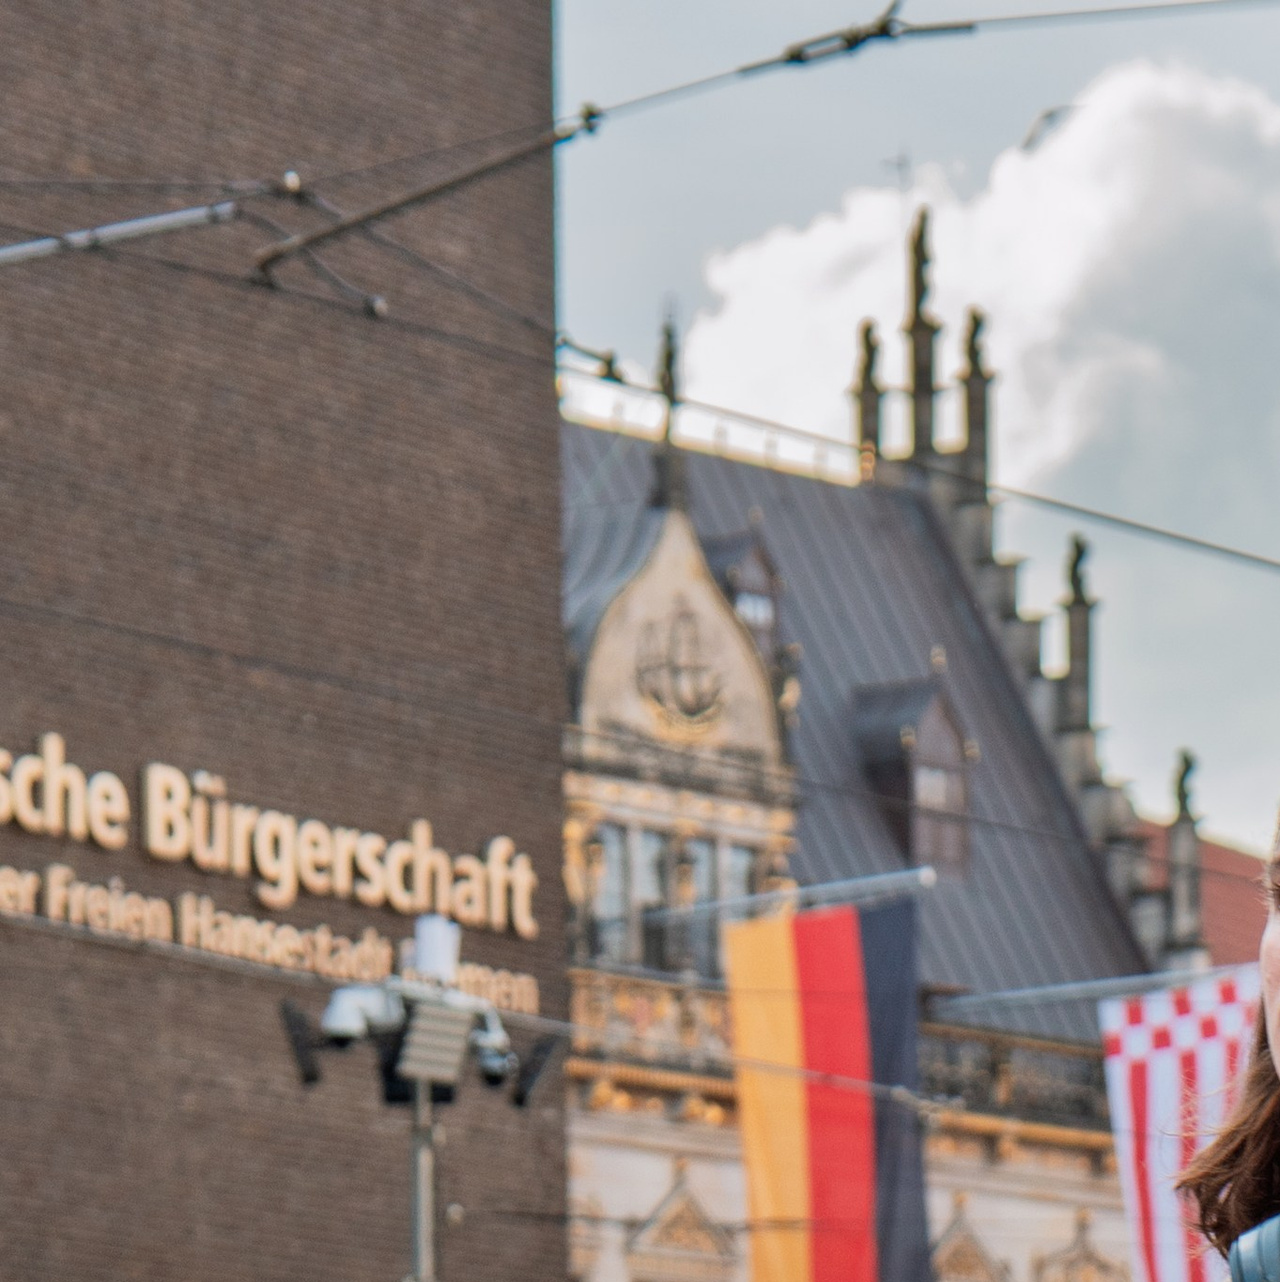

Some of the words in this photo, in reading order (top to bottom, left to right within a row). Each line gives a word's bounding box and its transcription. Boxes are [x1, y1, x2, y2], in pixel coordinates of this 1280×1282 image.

[46, 863, 174, 942] Freien
[179, 891, 393, 981] Hansestadt
[145, 762, 539, 940] Bürgerschaft
